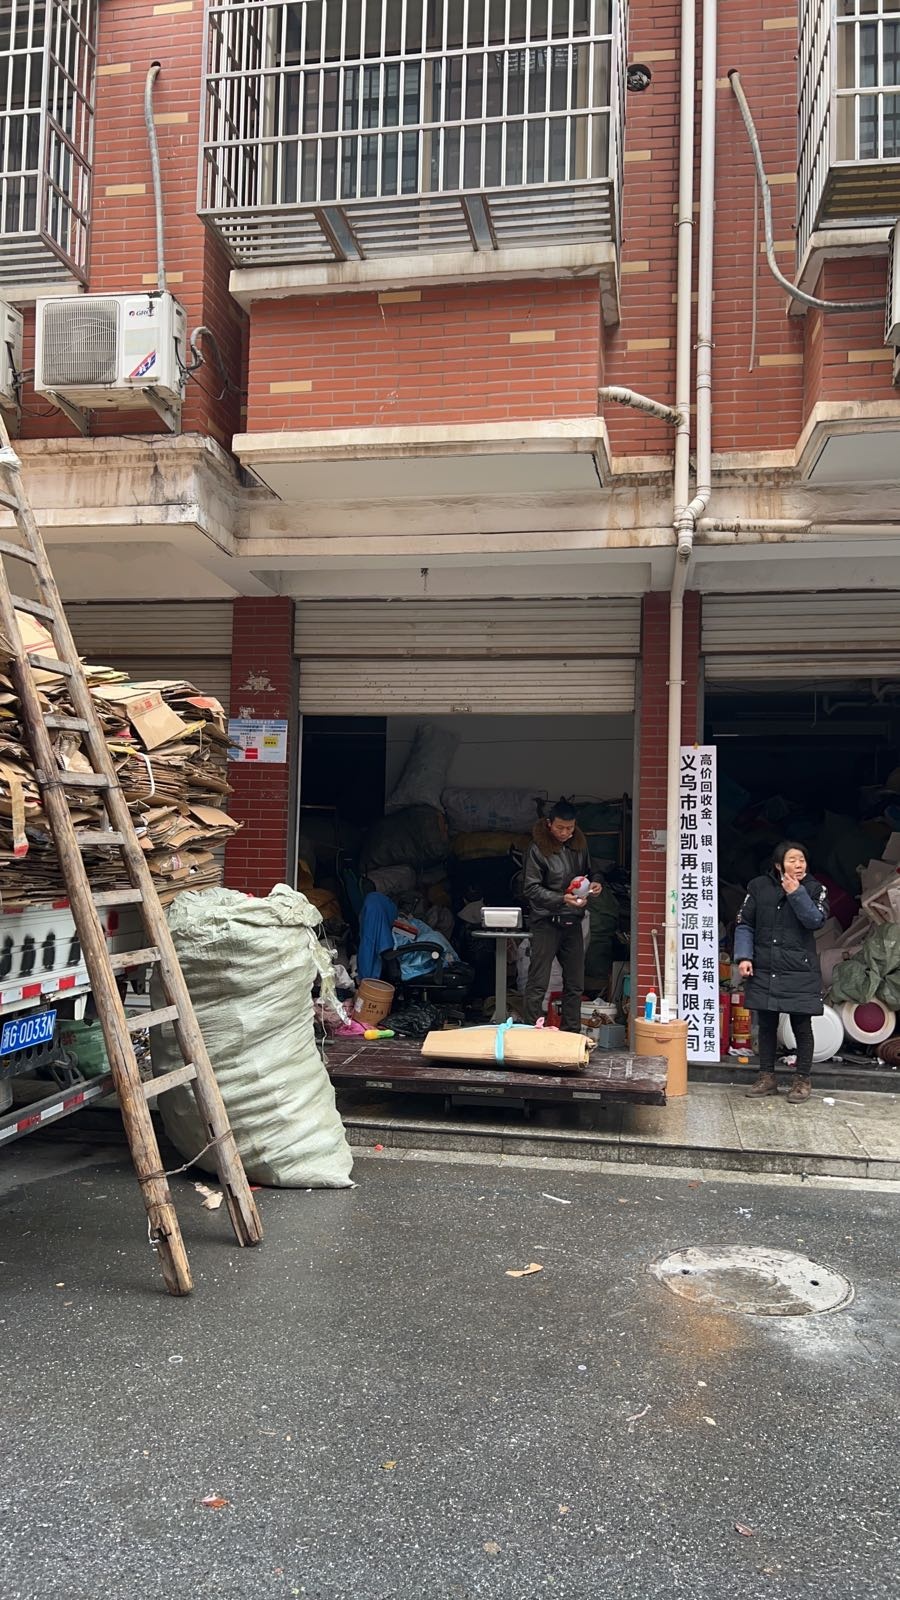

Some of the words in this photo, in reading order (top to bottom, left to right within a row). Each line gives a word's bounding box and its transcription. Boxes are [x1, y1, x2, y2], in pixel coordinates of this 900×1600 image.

[680, 754, 699, 1052] 义乌市旭凯再生资源回收有限公司
